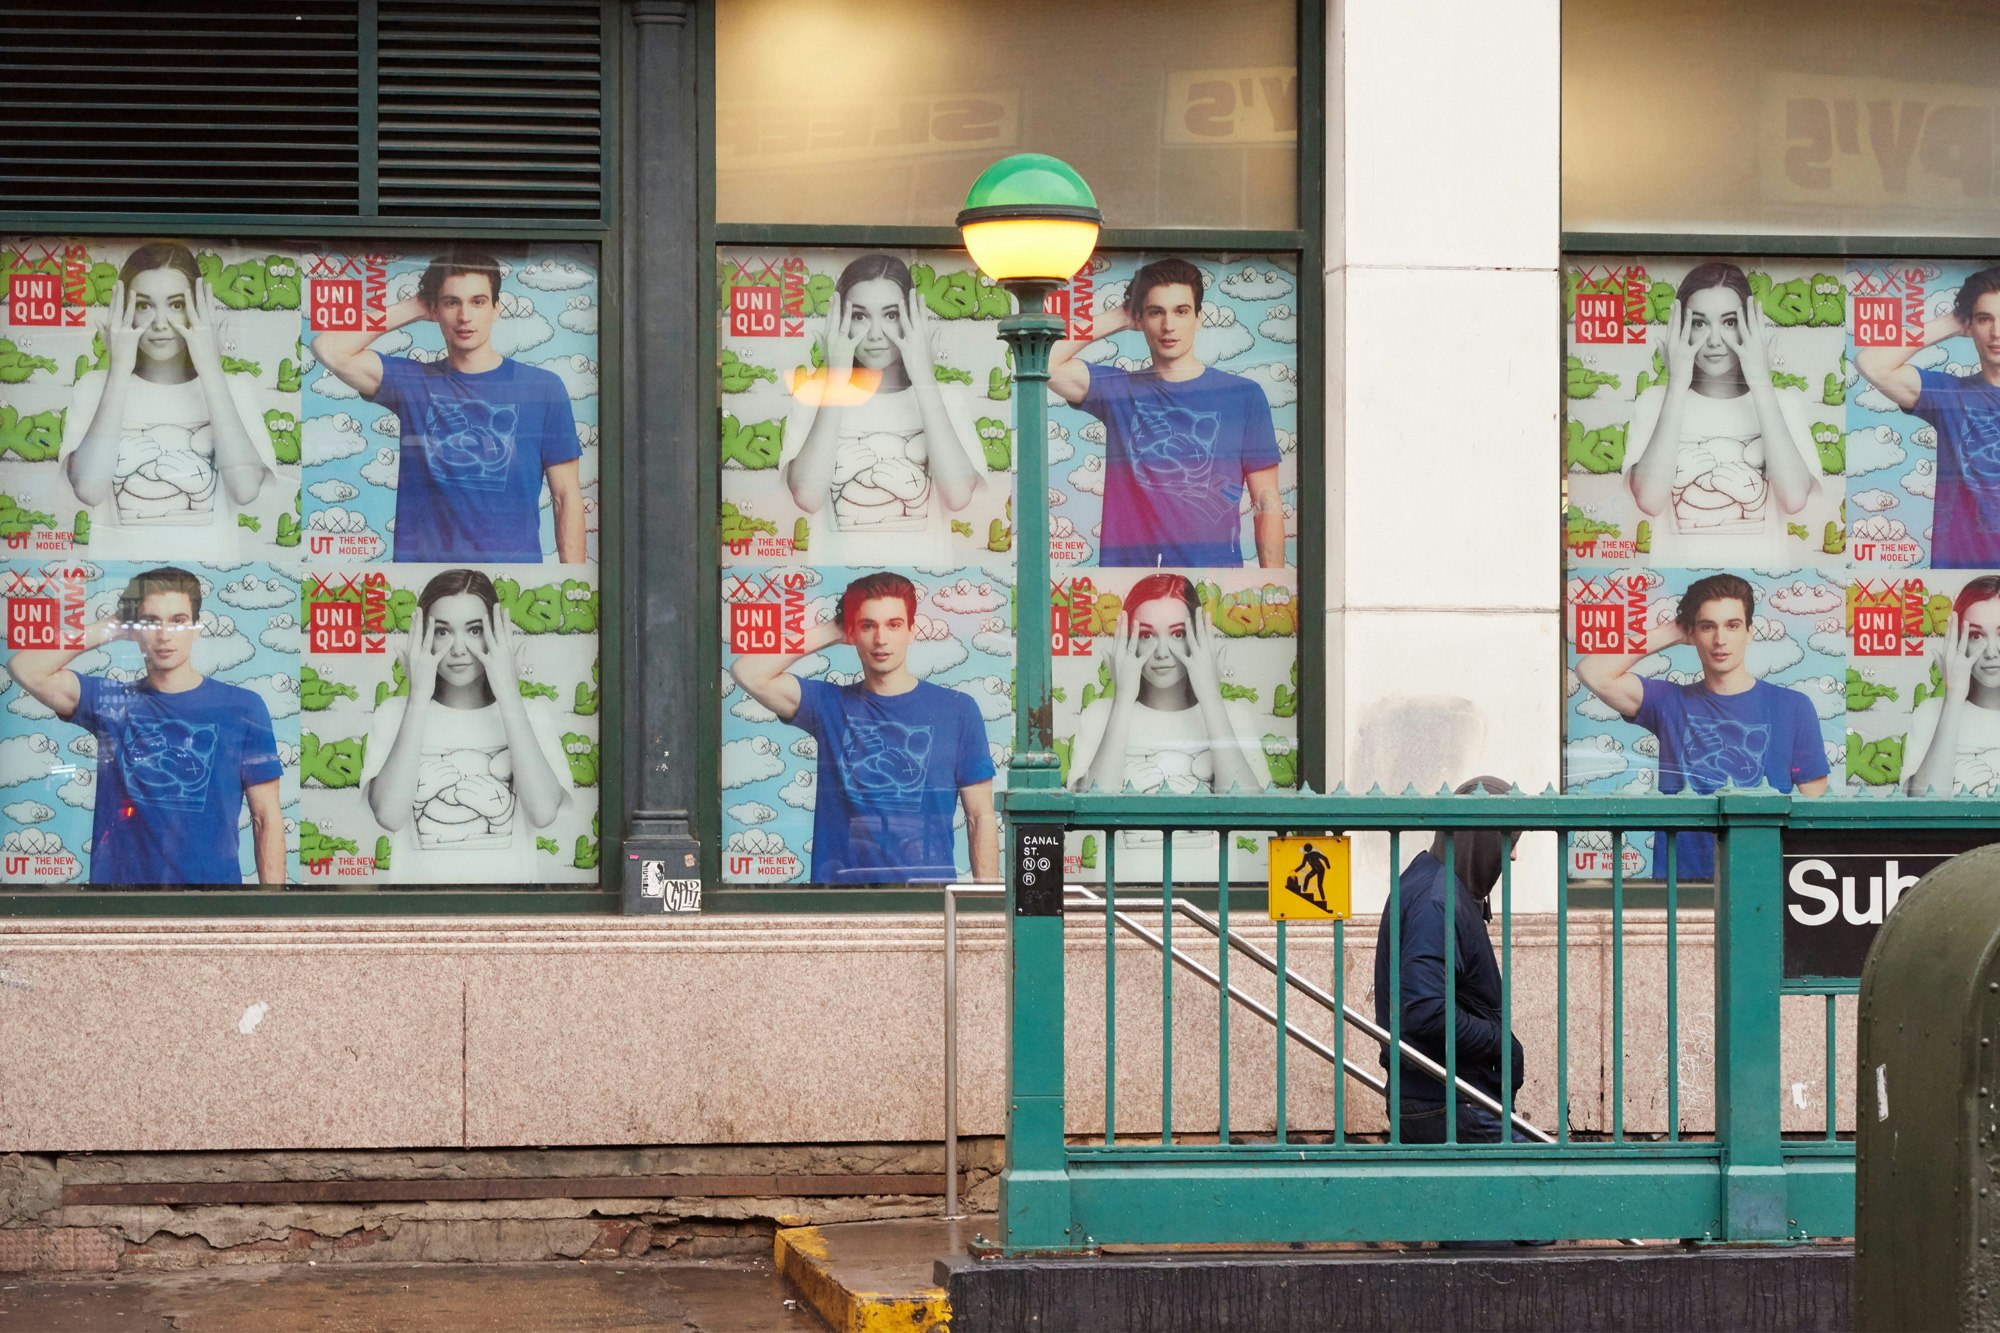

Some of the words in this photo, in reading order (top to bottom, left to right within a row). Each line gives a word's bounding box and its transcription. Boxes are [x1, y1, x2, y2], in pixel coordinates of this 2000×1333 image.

[15, 280, 52, 299] UNI
[65, 244, 87, 327] KAWS
[316, 286, 353, 304] UNI
[365, 251, 387, 332] KAWS
[736, 292, 772, 311] UNI
[783, 256, 805, 338] KAWS
[1043, 296, 1061, 314] NI
[1626, 264, 1647, 344] KAWS
[15, 301, 56, 323] QLO
[1581, 300, 1615, 318] UNI
[1859, 303, 1894, 321] UNI
[1904, 267, 1925, 347] KAWS
[316, 307, 357, 328] QLO
[736, 313, 775, 334] QLO
[1581, 320, 1618, 341] QLO
[1859, 323, 1897, 344] QLO
[7, 531, 31, 550] UT
[36, 531, 53, 540] THE
[55, 531, 76, 540] NEW
[339, 536, 356, 545] THE
[358, 536, 378, 545] NEW
[757, 537, 774, 547] THE
[776, 537, 795, 547] NEW
[1601, 540, 1617, 549] THE
[1619, 540, 1638, 549] NEW
[35, 542, 67, 550] MODEL
[69, 542, 75, 550] T
[310, 536, 334, 555] UT
[338, 546, 369, 555] MODEL
[371, 546, 377, 555] T
[729, 537, 753, 556] UT
[757, 548, 787, 557] MODEL
[789, 548, 795, 557] T
[1065, 541, 1084, 550] NEW
[1575, 540, 1597, 558] UT
[1601, 550, 1630, 559] MODEL
[1632, 550, 1638, 559] T
[1854, 543, 1876, 561] UT
[1880, 543, 1896, 552] THE
[1897, 543, 1916, 552] NEW
[1078, 551, 1084, 560] T
[1880, 553, 1909, 562] MODEL
[1910, 553, 1916, 562] T
[13, 604, 51, 623] UNI
[63, 567, 85, 650] KAWS
[316, 608, 353, 627] UNI
[364, 572, 386, 654] KAWS
[783, 573, 805, 654] KAWS
[1071, 576, 1093, 657] KAWS
[1626, 575, 1648, 655] KAWS
[1903, 577, 1924, 656] KAWS
[736, 609, 772, 628] UNI
[1581, 610, 1616, 628] UNI
[1859, 612, 1893, 631] UNI
[13, 625, 55, 647] QLO
[316, 629, 357, 651] QLO
[736, 630, 776, 651] QLO
[1581, 631, 1619, 652] QLO
[1859, 633, 1897, 654] QLO
[1023, 835, 1059, 846] CANAL
[35, 856, 52, 865] THE
[54, 856, 74, 865] NEW
[757, 856, 775, 865] THE
[776, 856, 796, 865] NEW
[1023, 847, 1040, 856] ST.
[1064, 855, 1083, 864] NEW
[1575, 852, 1598, 870] UT
[1602, 852, 1613, 861] TH
[5, 856, 30, 876] UT
[309, 857, 334, 876] UT
[338, 857, 355, 866] THE
[356, 857, 377, 866] NEW
[730, 856, 754, 875] UT
[757, 867, 788, 875] MODEL
[790, 867, 796, 875] T
[1601, 862, 1631, 871] MOEL
[1632, 862, 1638, 871] T
[34, 867, 66, 876] MODEL
[68, 867, 74, 876] T
[337, 867, 369, 876] MODEL
[371, 867, 377, 876] T
